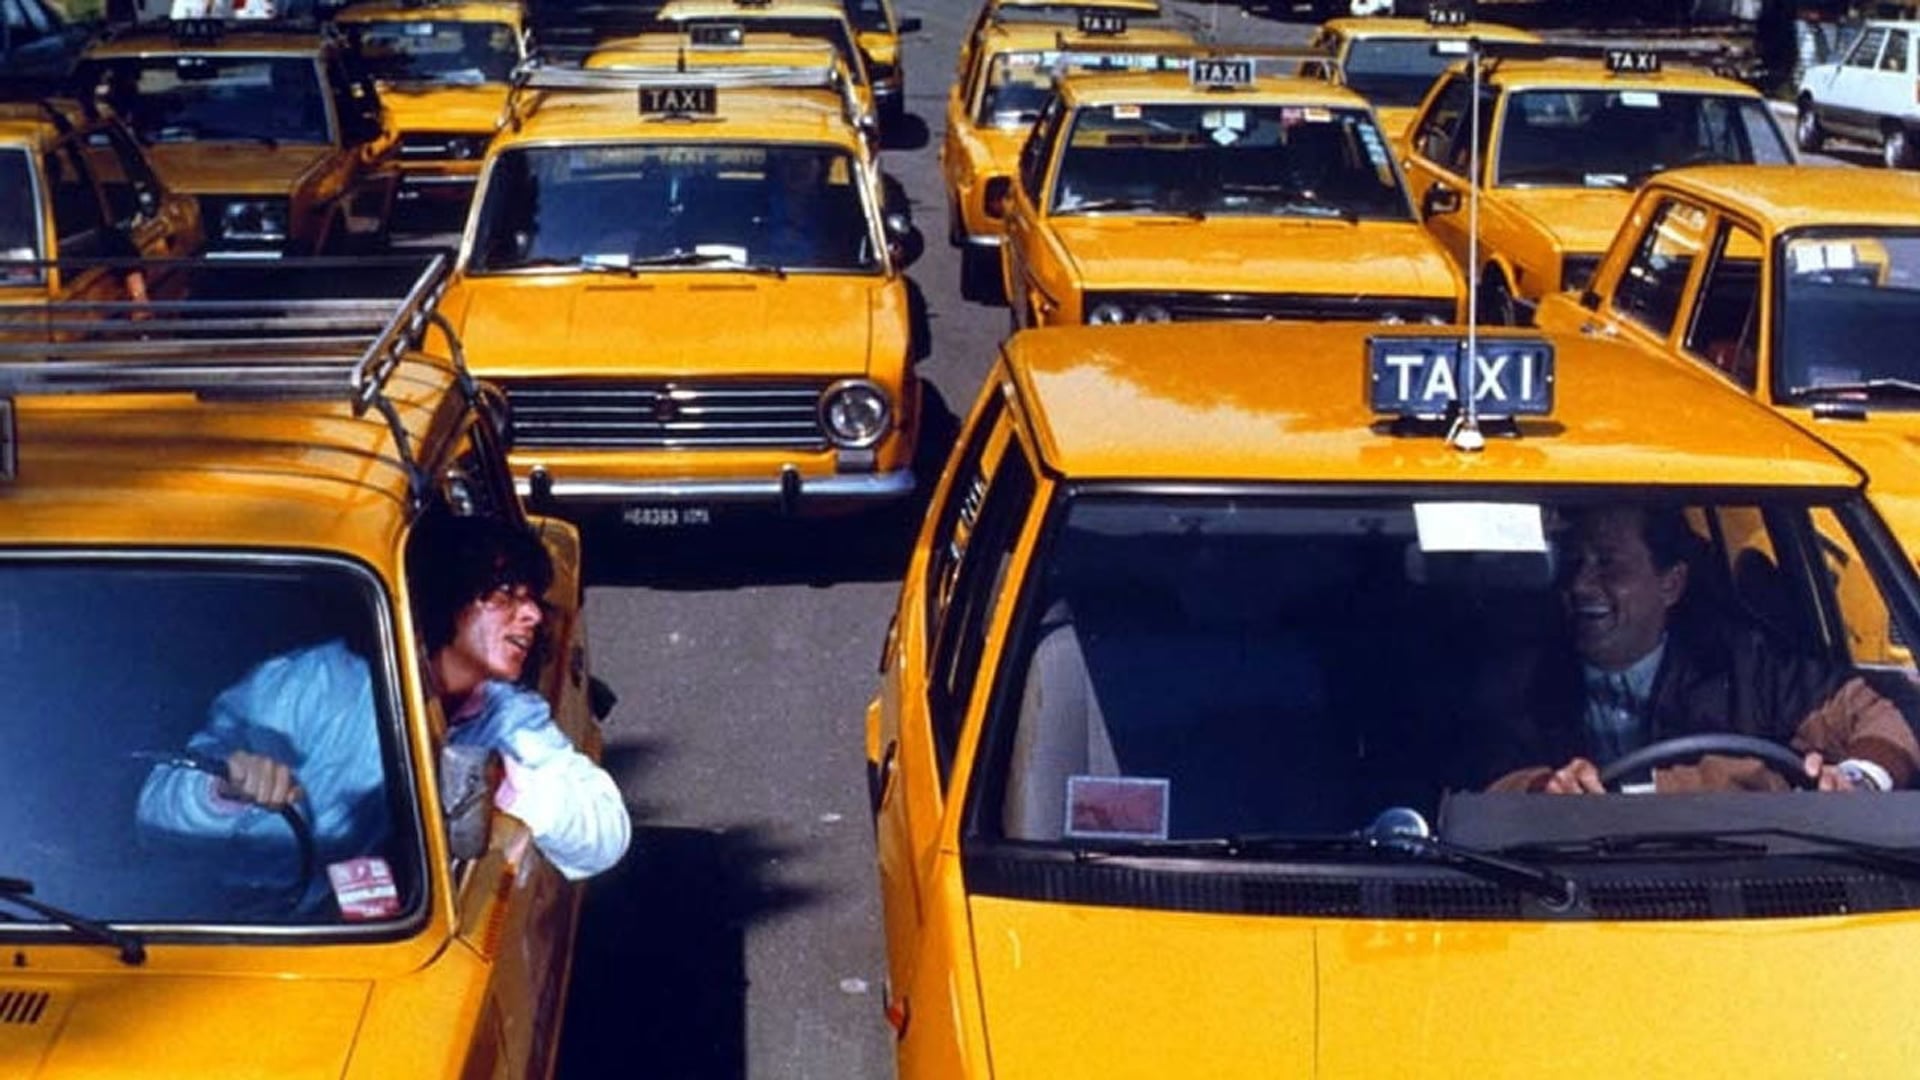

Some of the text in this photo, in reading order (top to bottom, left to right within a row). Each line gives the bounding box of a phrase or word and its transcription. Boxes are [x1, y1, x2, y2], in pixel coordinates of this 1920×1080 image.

[1082, 15, 1122, 29] TAXI
[1428, 9, 1466, 22] TAXI
[1609, 51, 1657, 69] TAXI
[1200, 63, 1246, 82] TAXI
[649, 90, 706, 109] TAXI
[1386, 355, 1533, 401] TAXI
